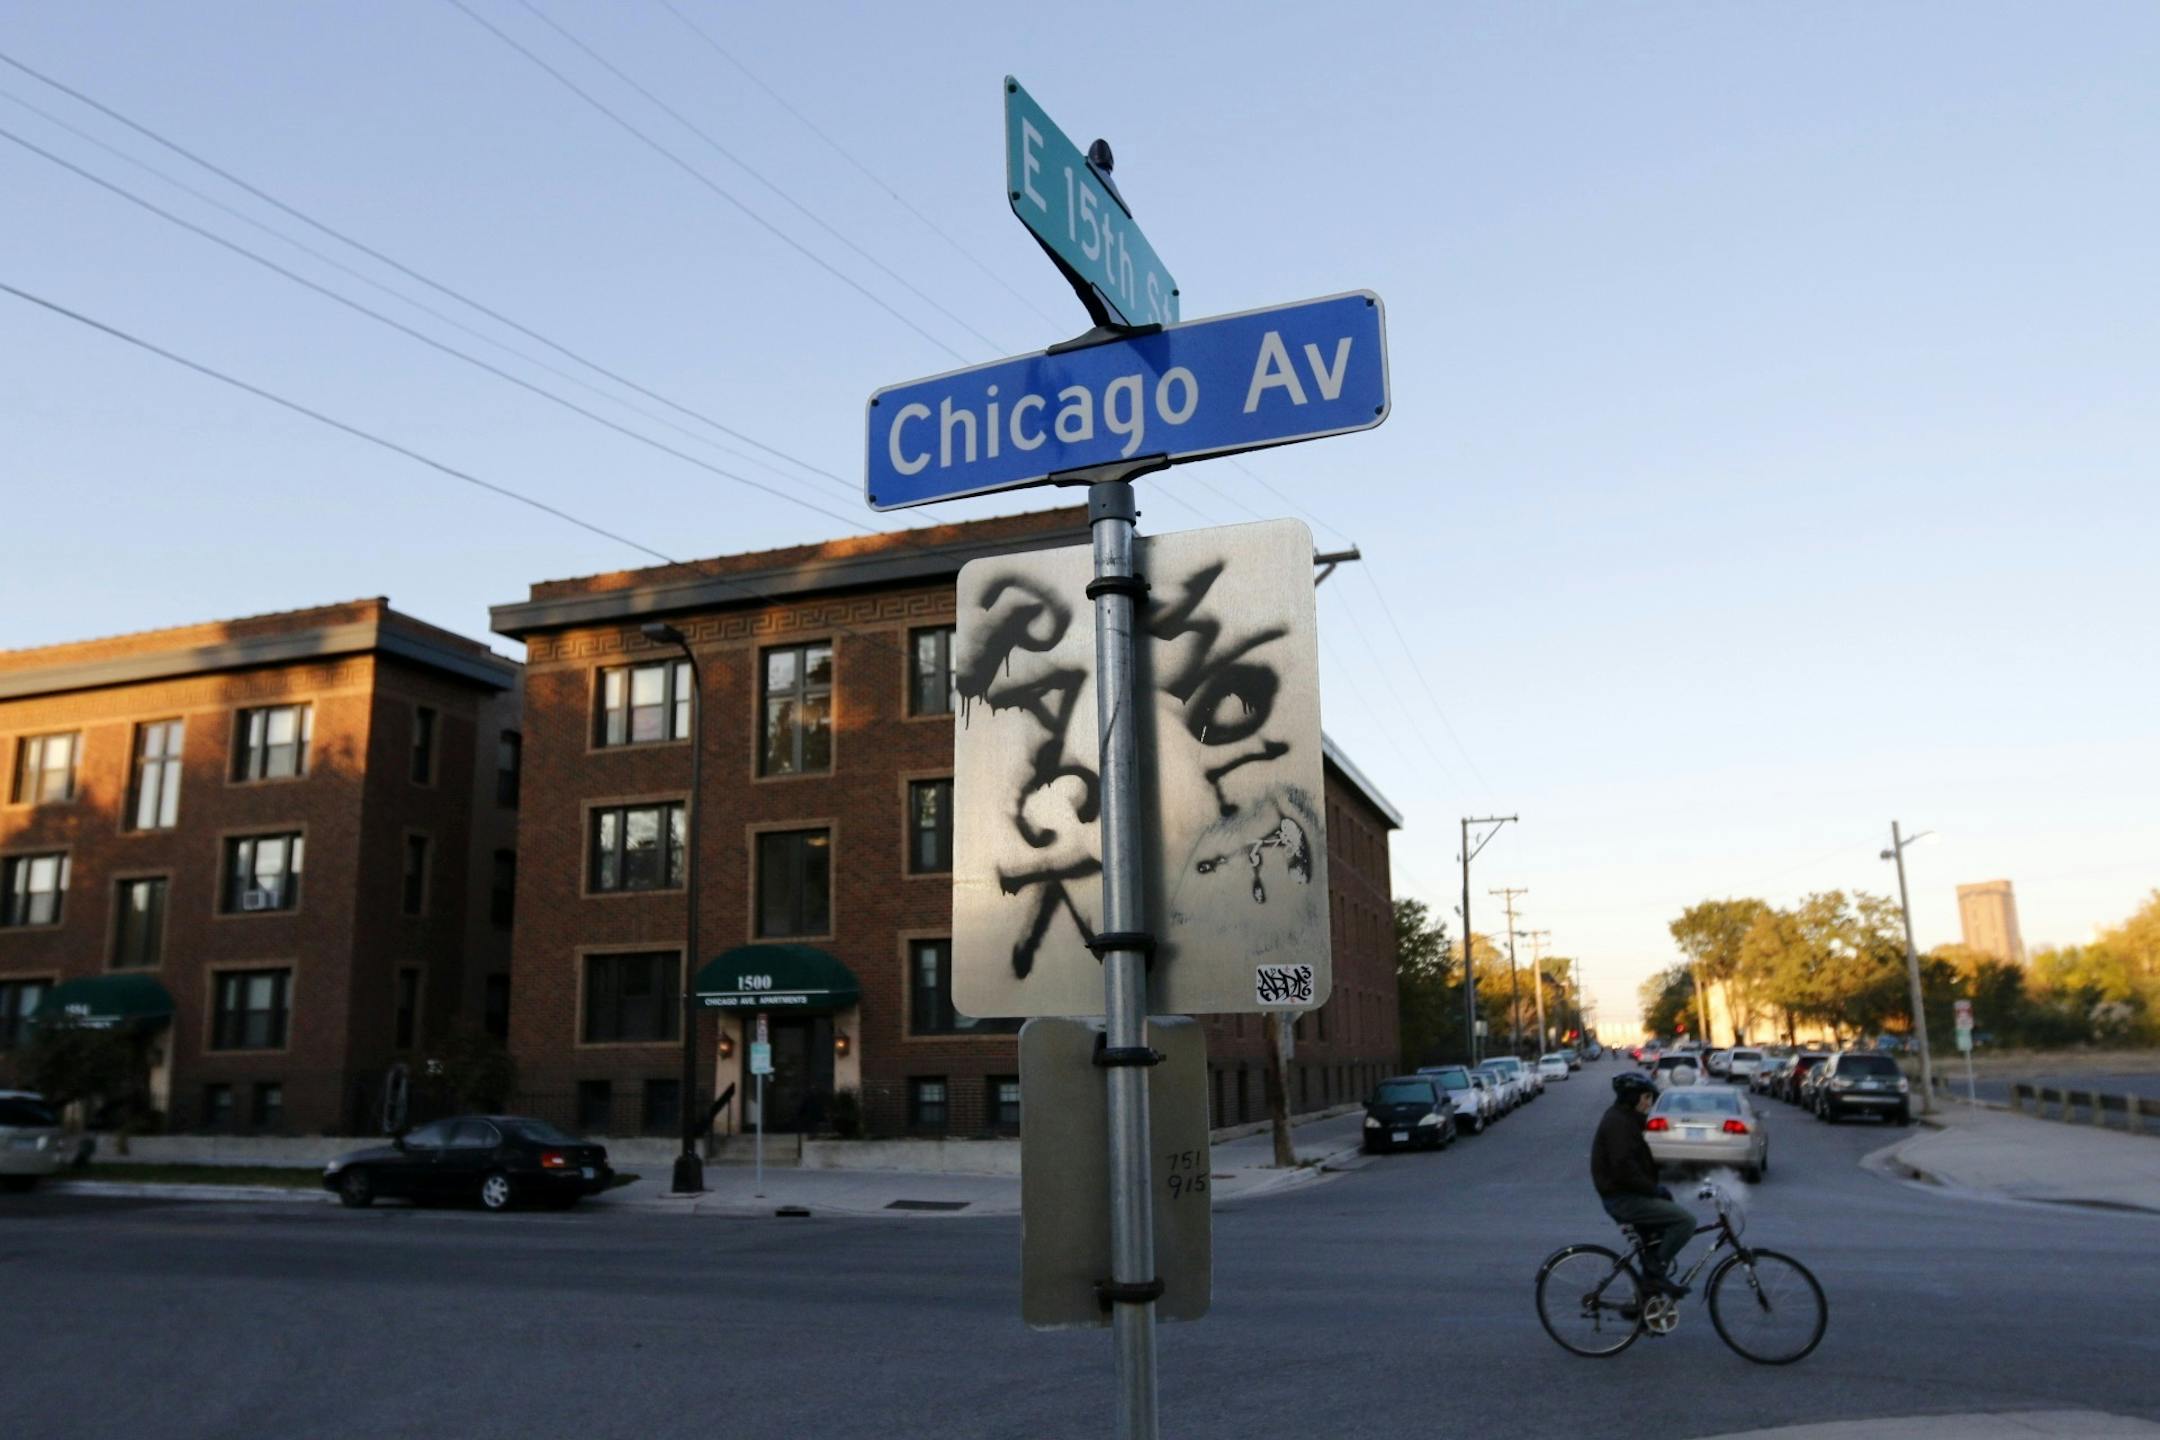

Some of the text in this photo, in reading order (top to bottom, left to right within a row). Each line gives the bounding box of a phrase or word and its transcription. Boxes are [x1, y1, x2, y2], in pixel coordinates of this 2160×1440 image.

[1021, 116, 1047, 213] E
[1063, 165, 1136, 310] 15th
[888, 330, 1353, 476] Chicago Av
[737, 974, 773, 991] 1500
[704, 997, 738, 1006] CHICAGO
[1166, 1150, 1201, 1171] 751
[1168, 1173, 1208, 1199] 915
